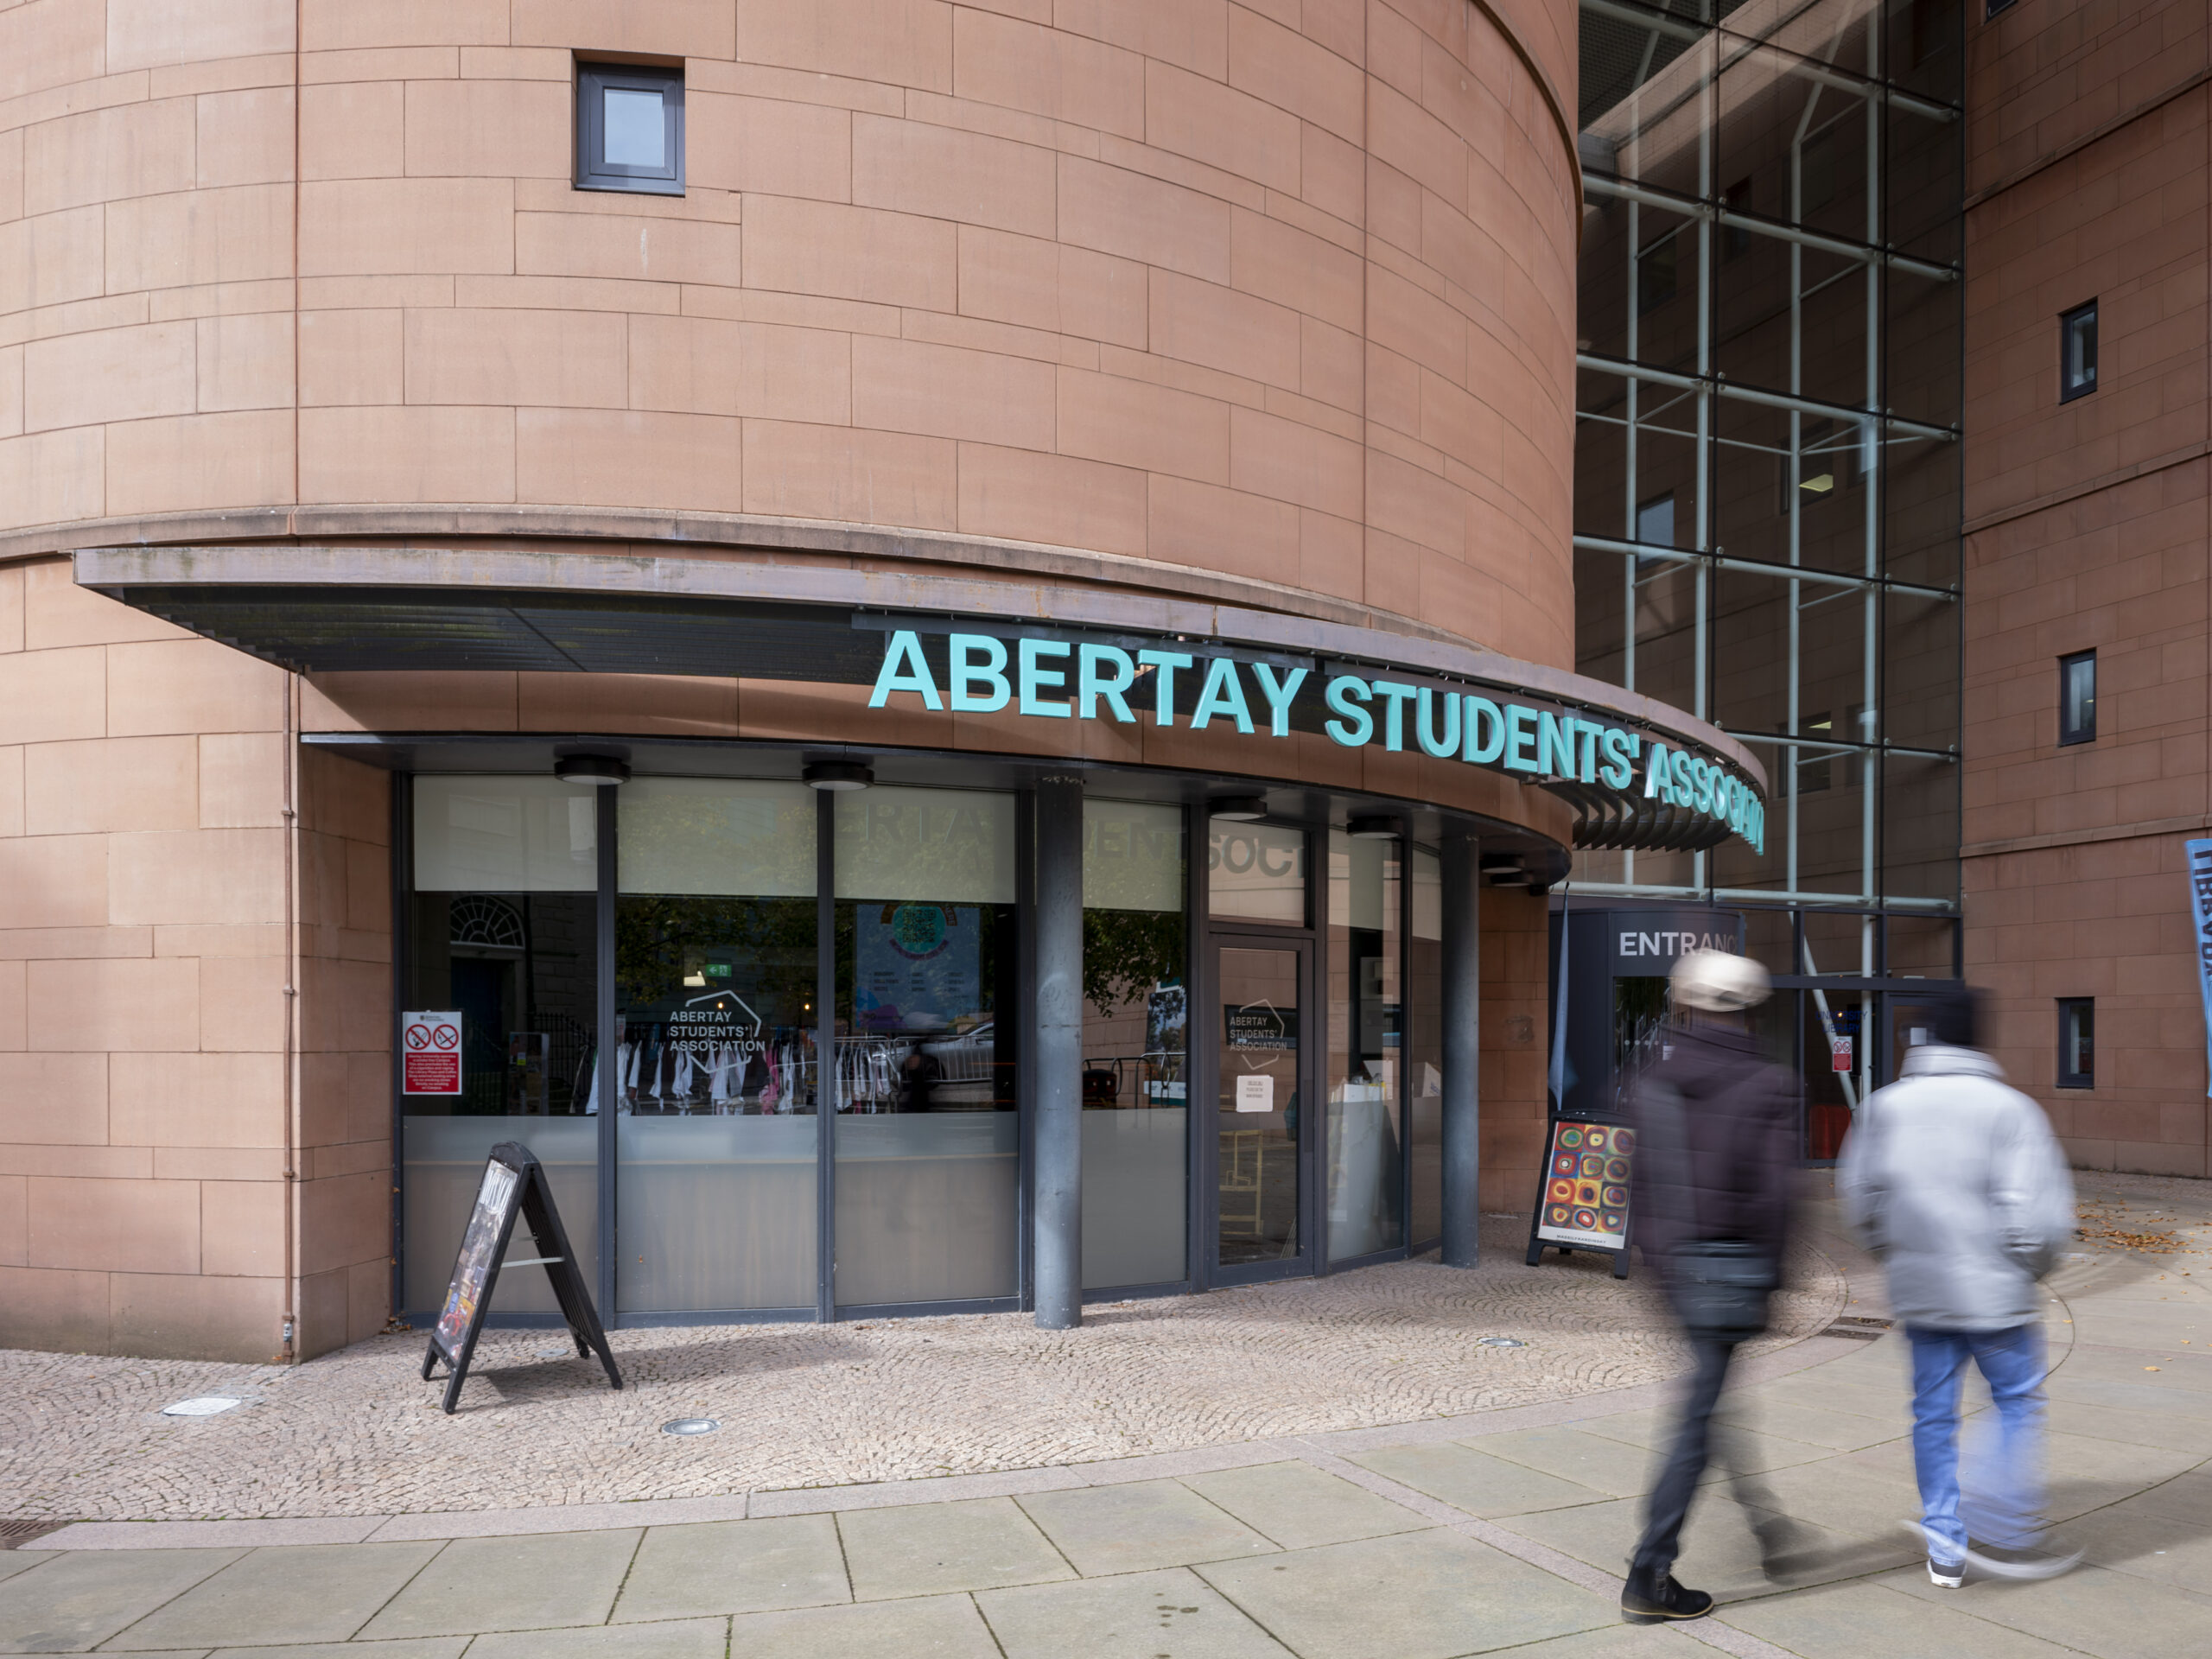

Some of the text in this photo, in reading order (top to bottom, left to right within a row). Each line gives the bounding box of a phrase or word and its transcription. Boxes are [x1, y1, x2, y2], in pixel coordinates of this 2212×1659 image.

[868, 630, 1308, 737] ABERTAY
[1325, 675, 1640, 790] STUDENTS'
[1619, 931, 1738, 957] ENTRANC
[670, 1011, 732, 1022] ABERTAY
[1230, 1016, 1268, 1026] ABERTAY
[670, 1026, 748, 1037] STUDENTS'
[1230, 1029, 1277, 1039] STUDENTS'
[670, 1040, 766, 1052] ASSOCIATION
[1230, 1042, 1287, 1052] ASSOCIATION
